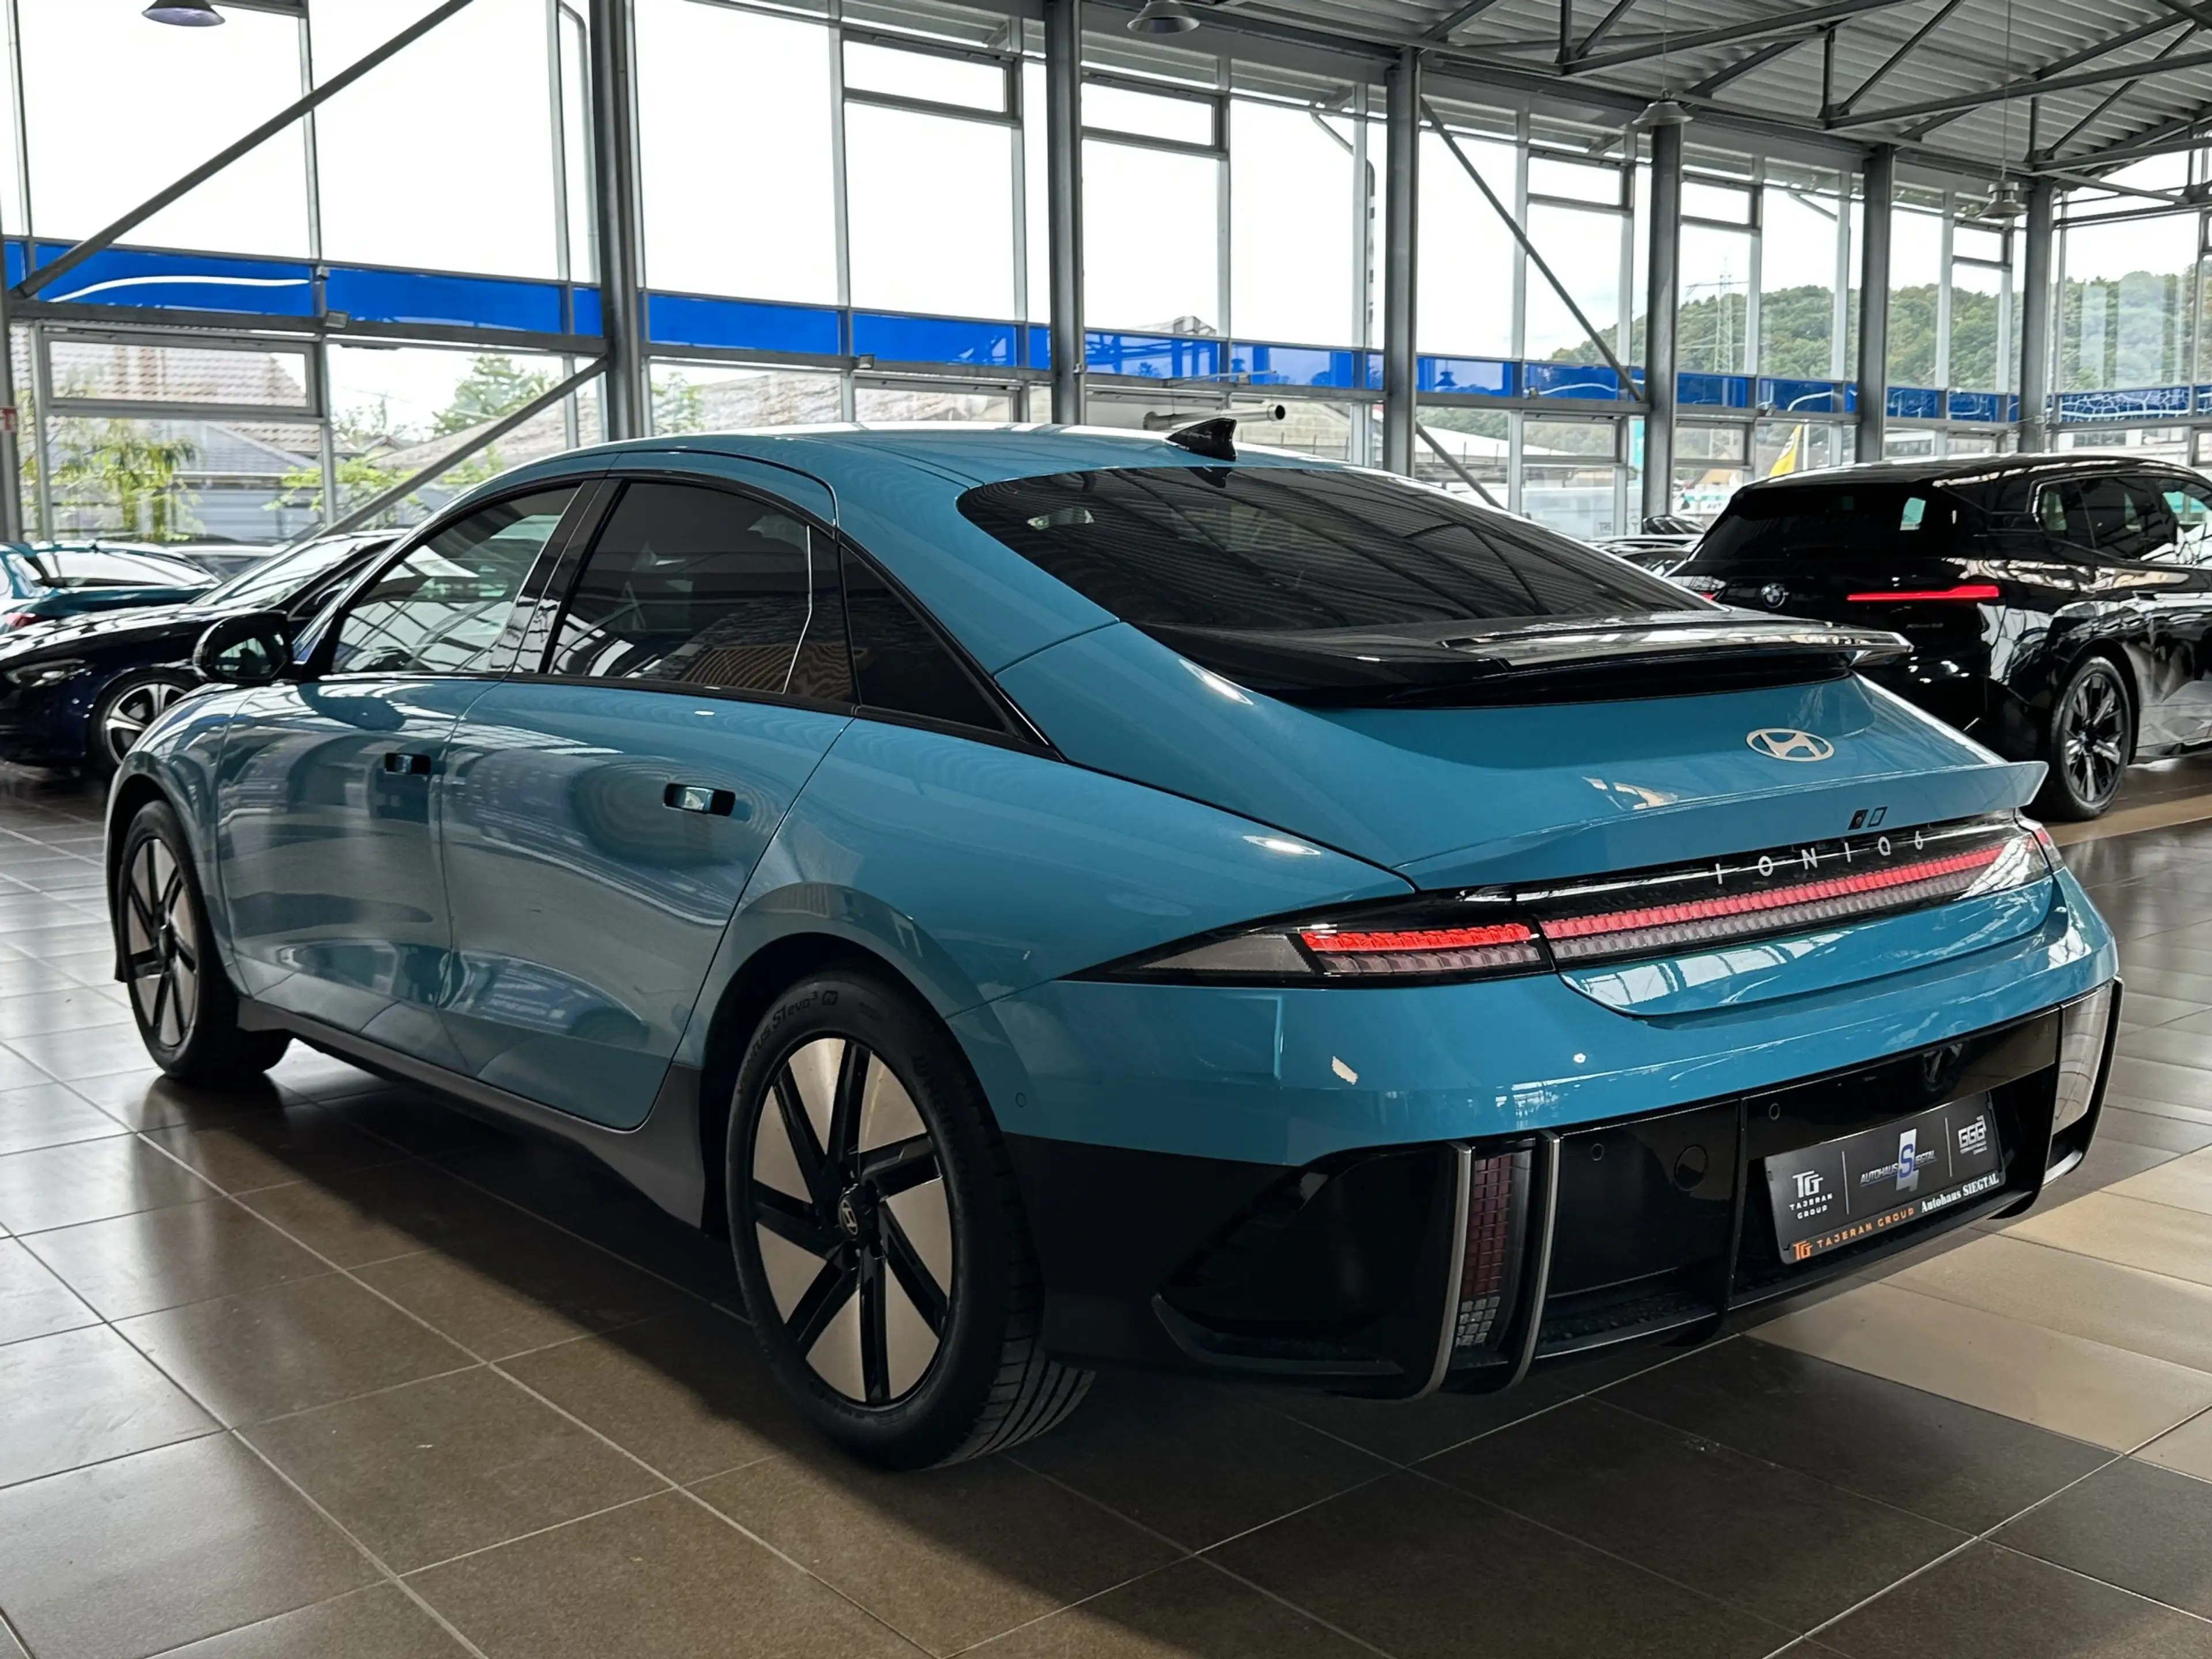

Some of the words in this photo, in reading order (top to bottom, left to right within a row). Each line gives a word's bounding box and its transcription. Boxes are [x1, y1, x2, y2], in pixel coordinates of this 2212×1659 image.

[1715, 836, 1891, 885] IONIQ
[1914, 831, 1924, 851] 6
[1859, 1162, 1899, 1184] AUTOHAUS
[1789, 1192, 1833, 1211] TAJERAN
[1797, 1205, 1828, 1219] GROUP
[1816, 1222, 1873, 1249] TAJERAN
[1877, 1207, 1915, 1228] GROUP
[1921, 1190, 1962, 1214] Autohaus
[1962, 1173, 1999, 1196] SIEGTAL
